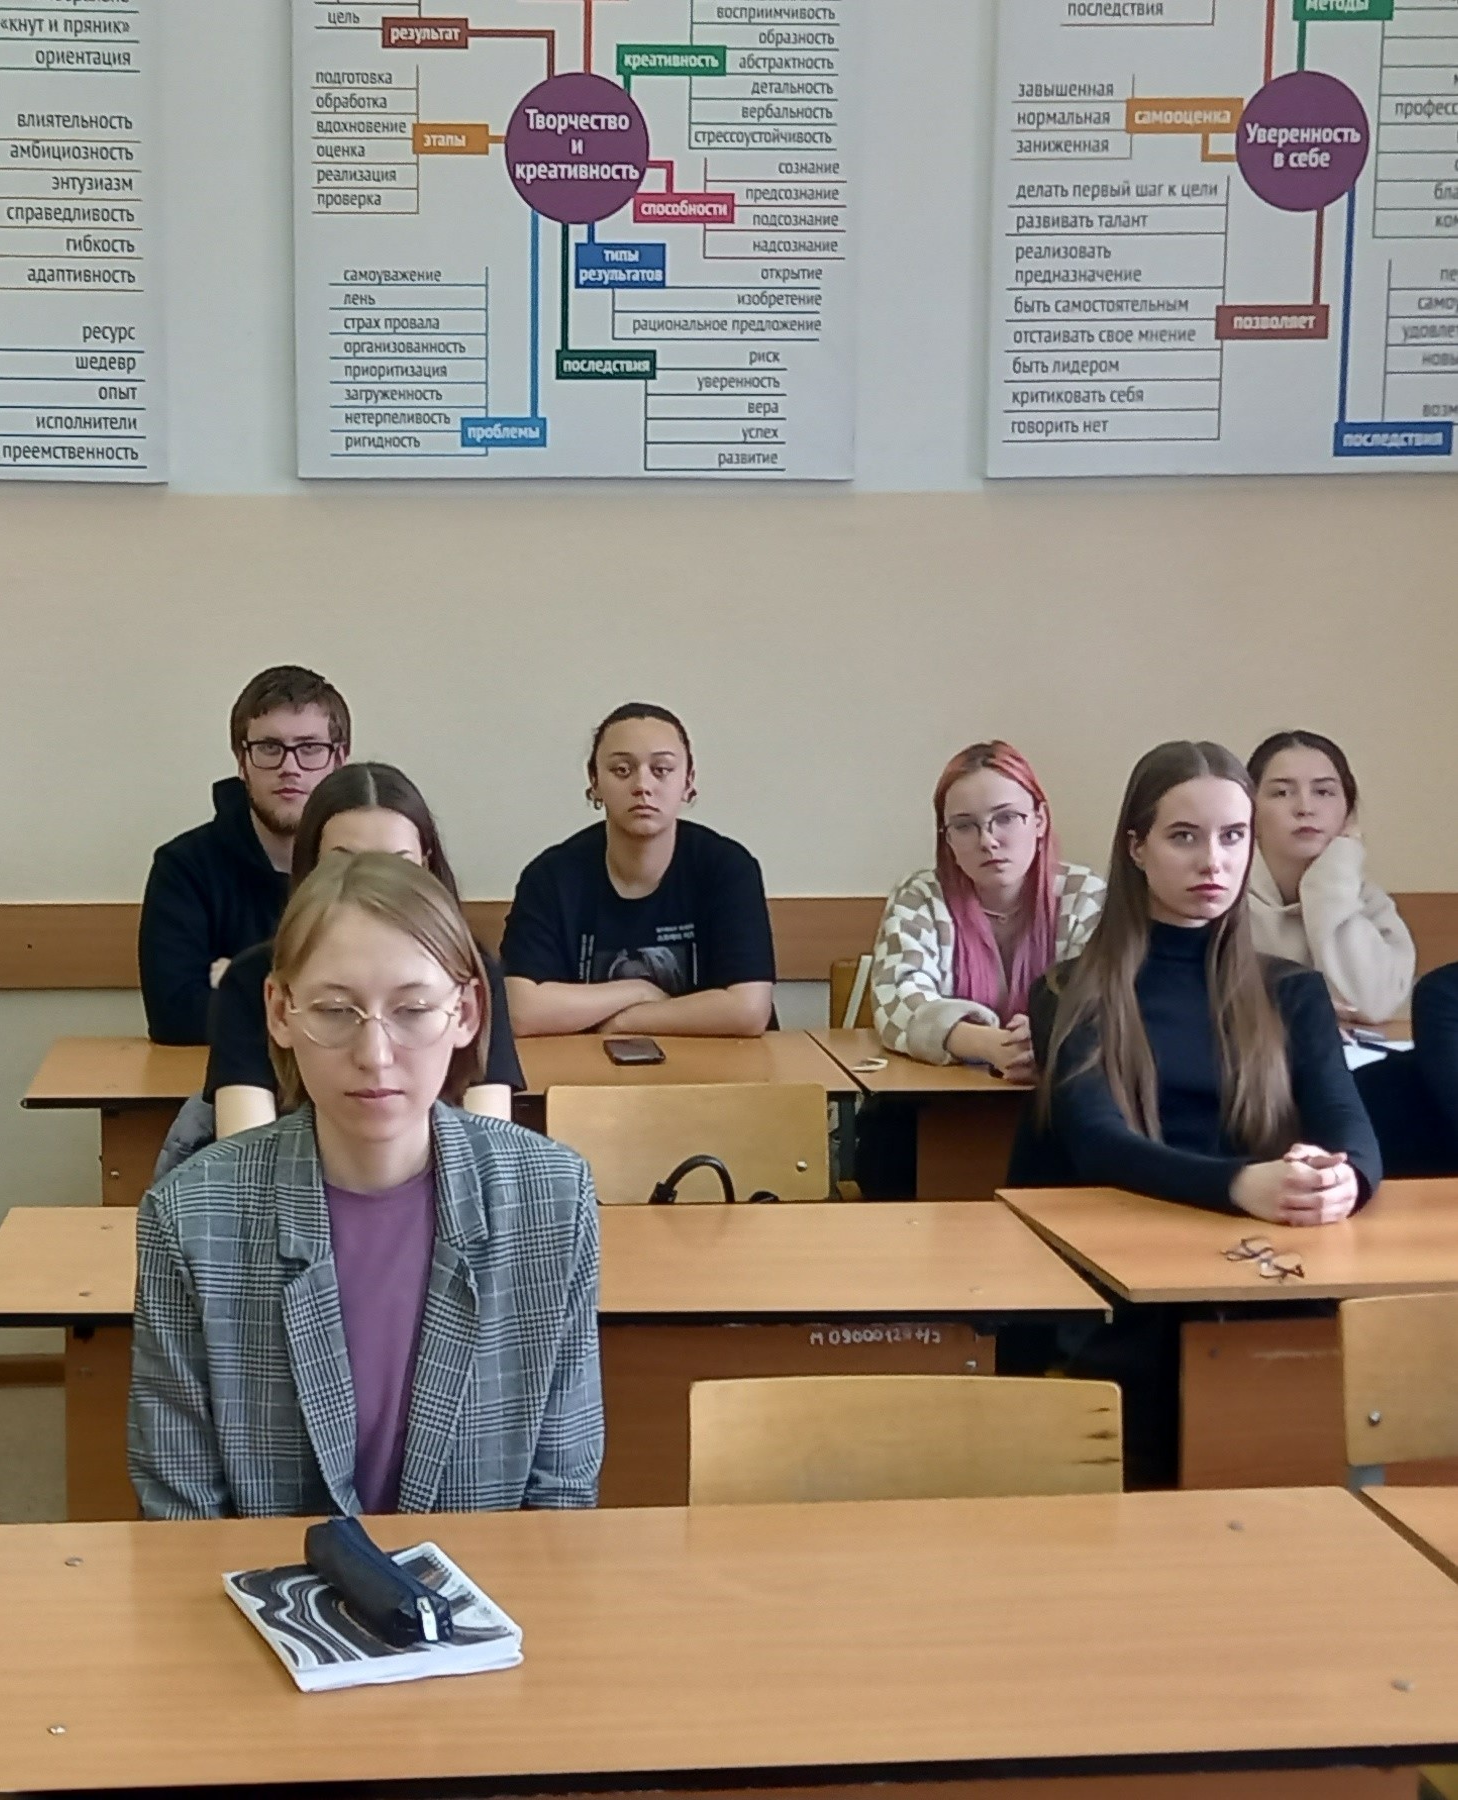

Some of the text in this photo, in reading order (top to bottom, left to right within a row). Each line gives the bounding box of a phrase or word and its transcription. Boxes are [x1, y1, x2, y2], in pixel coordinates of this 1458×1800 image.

[716, 6, 836, 22] восприимчивость
[1068, 2, 1164, 18] последствия
[328, 12, 360, 25] цель
[0, 20, 130, 36] «кнут и пряник»
[390, 26, 460, 45] результат
[758, 31, 835, 48] образность
[36, 51, 131, 67] ориентация
[624, 53, 719, 69] креативность
[739, 56, 834, 71] абстрактность
[316, 71, 392, 85] подготовка
[751, 82, 834, 96] детальность
[1018, 82, 1114, 98] завышенная
[316, 94, 388, 112] обработка
[742, 104, 832, 122] вербальность
[1017, 111, 1110, 130] нормальная
[1134, 110, 1231, 126] самооценка
[18, 114, 133, 130] влиятельность
[316, 120, 406, 134] вдохновение
[525, 108, 630, 136] Творчество
[424, 134, 466, 148] этапы
[694, 130, 832, 147] стрессоустойчивость
[1246, 122, 1361, 147] Уверенность
[10, 142, 134, 162] амбициозность
[316, 146, 365, 158] оценка
[570, 139, 584, 154] и
[1016, 140, 1110, 153] заниженная
[1273, 147, 1331, 168] в себе
[317, 168, 396, 183] реализация
[515, 162, 640, 186] креативность
[778, 162, 840, 174] сознание
[52, 176, 133, 194] энтузиазм
[1016, 180, 1218, 201] делать первый шаг к цели
[318, 194, 382, 208] проверка
[746, 188, 840, 202] предсознание
[7, 206, 134, 224] справедливость
[641, 200, 728, 218] способности
[752, 213, 838, 227] подсознание
[1016, 214, 1148, 232] развивать талант
[66, 235, 135, 252] гибкость
[753, 240, 838, 253] надсознание
[604, 250, 640, 263] типы
[1015, 246, 1112, 264] реализовать
[28, 268, 136, 284] адаптивность
[344, 270, 442, 284] самоуважение
[579, 267, 664, 286] результатов
[760, 268, 823, 282] открытие
[1015, 268, 1142, 286] предназначение
[344, 294, 376, 306] лень
[737, 292, 822, 308] изобретение
[1014, 296, 1189, 314] быть самостоятельным
[344, 316, 440, 332] страх провала
[633, 318, 822, 334] рациональное предложение
[1233, 315, 1316, 330] позволяет
[82, 326, 135, 343] ресурс
[1013, 329, 1196, 344] отстаивать свое мнение
[344, 340, 466, 356] организованность
[76, 356, 136, 374] шедевр
[749, 351, 780, 365] риск
[344, 364, 448, 380] приоритизация
[562, 358, 650, 375] последствия
[1012, 358, 1120, 376] быть лидером
[697, 376, 780, 390] уверенность
[98, 388, 138, 400] опыт
[344, 389, 442, 404] загруженность
[1012, 386, 1144, 405] критиковать себя
[748, 401, 778, 416] вера
[36, 416, 138, 430] исполнители
[344, 412, 450, 426] нетерпеливость
[468, 424, 540, 444] проблемы
[742, 426, 778, 442] успех
[1011, 420, 1108, 436] говорить нет
[345, 436, 420, 450] ригидность
[2, 446, 139, 461] преемственность
[718, 452, 778, 467] развитие
